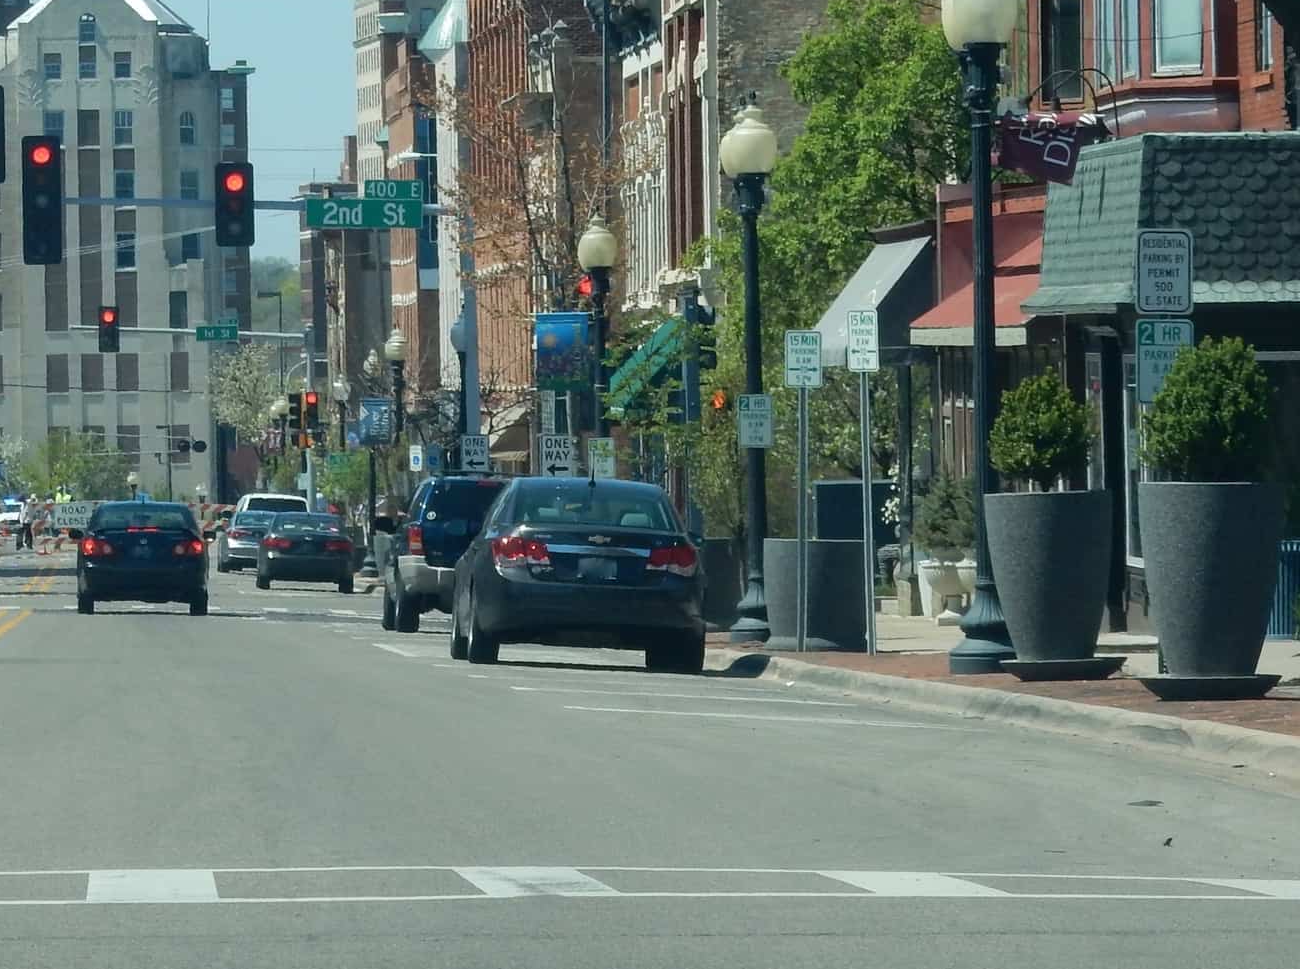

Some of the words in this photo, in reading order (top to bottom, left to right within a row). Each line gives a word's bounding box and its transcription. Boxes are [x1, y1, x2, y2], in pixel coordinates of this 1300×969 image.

[366, 182, 397, 198] 400
[411, 182, 420, 197] E
[322, 201, 363, 225] 2nd
[383, 202, 406, 226] St
[1147, 268, 1181, 279] PERMIT
[1155, 281, 1174, 292] 500
[1156, 295, 1183, 306] STATE
[1141, 323, 1153, 344] 2
[1162, 327, 1181, 342] HR
[790, 335, 800, 346] 15
[801, 335, 818, 346] MIN
[740, 397, 749, 410] 2
[464, 437, 485, 448] ONE
[545, 437, 570, 449] ONE
[464, 448, 485, 458] WAY
[545, 450, 571, 462] WAY
[61, 505, 86, 514] ROAD
